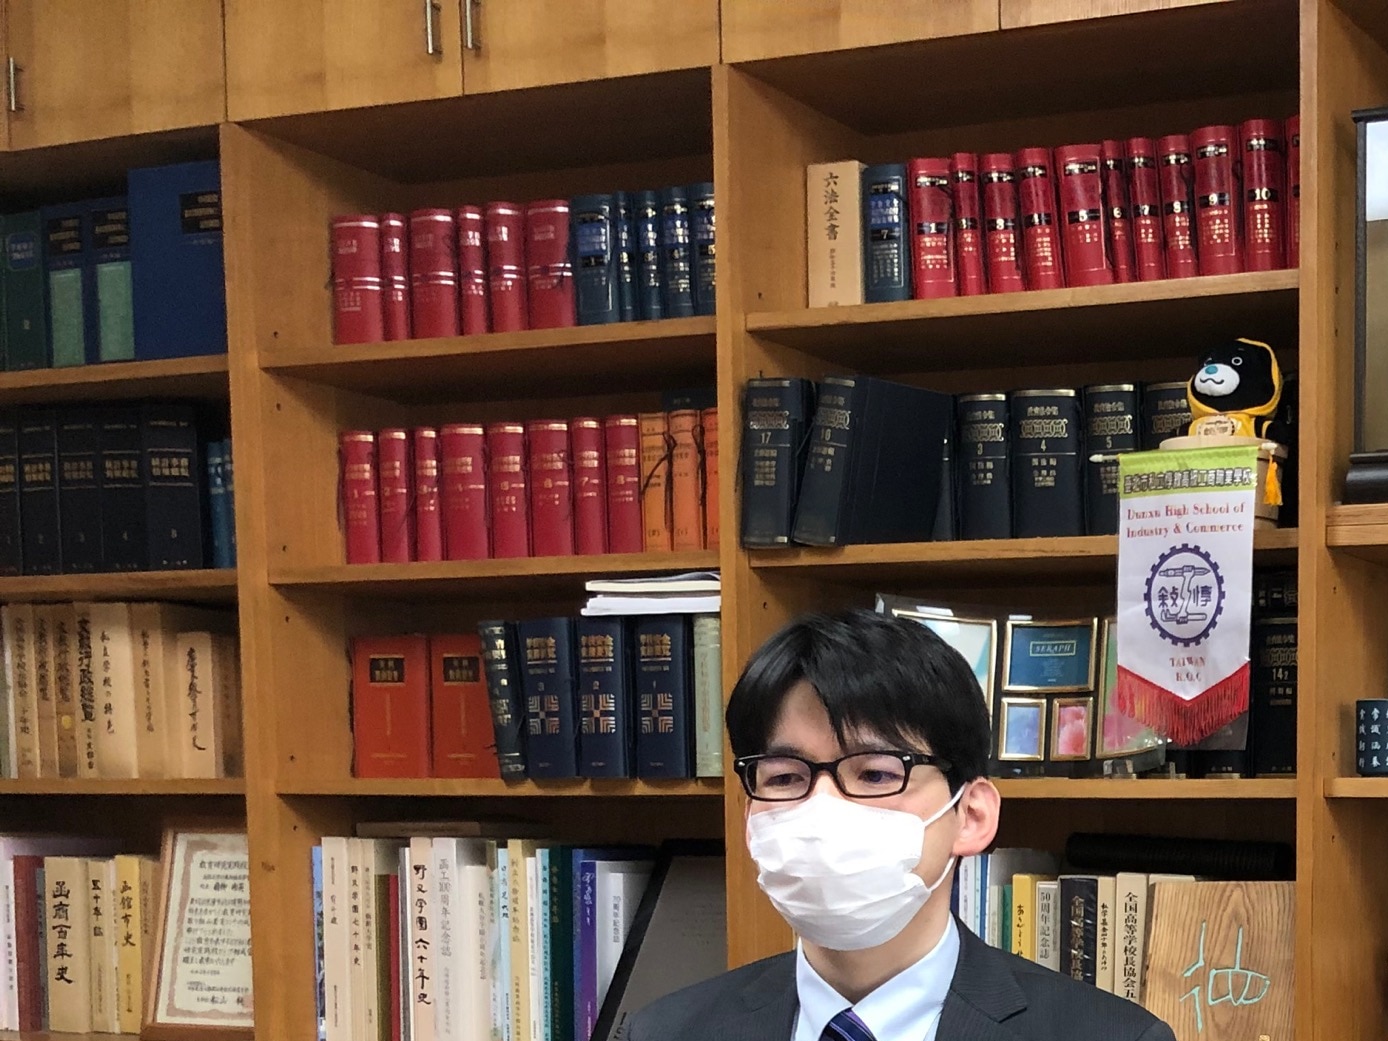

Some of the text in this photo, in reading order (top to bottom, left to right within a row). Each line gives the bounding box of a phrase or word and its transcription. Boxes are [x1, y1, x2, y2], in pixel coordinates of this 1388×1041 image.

[824, 172, 840, 240] 六法全書
[761, 432, 771, 444] 17
[1040, 440, 1047, 452] 4
[1106, 437, 1112, 448] 5
[977, 443, 983, 453] 3
[1165, 504, 1189, 518] High
[1193, 503, 1229, 515] School
[1233, 502, 1245, 513] of
[1127, 522, 1244, 538] Industry & Commerce
[1034, 643, 1072, 653] SERAPH
[1168, 656, 1206, 669] TAIWAN
[119, 880, 136, 947] 函館市史
[52, 880, 74, 985] 函商百年史
[1039, 892, 1051, 959] 50周年記念誌
[1123, 892, 1138, 999] 全国高等学校長協会五
